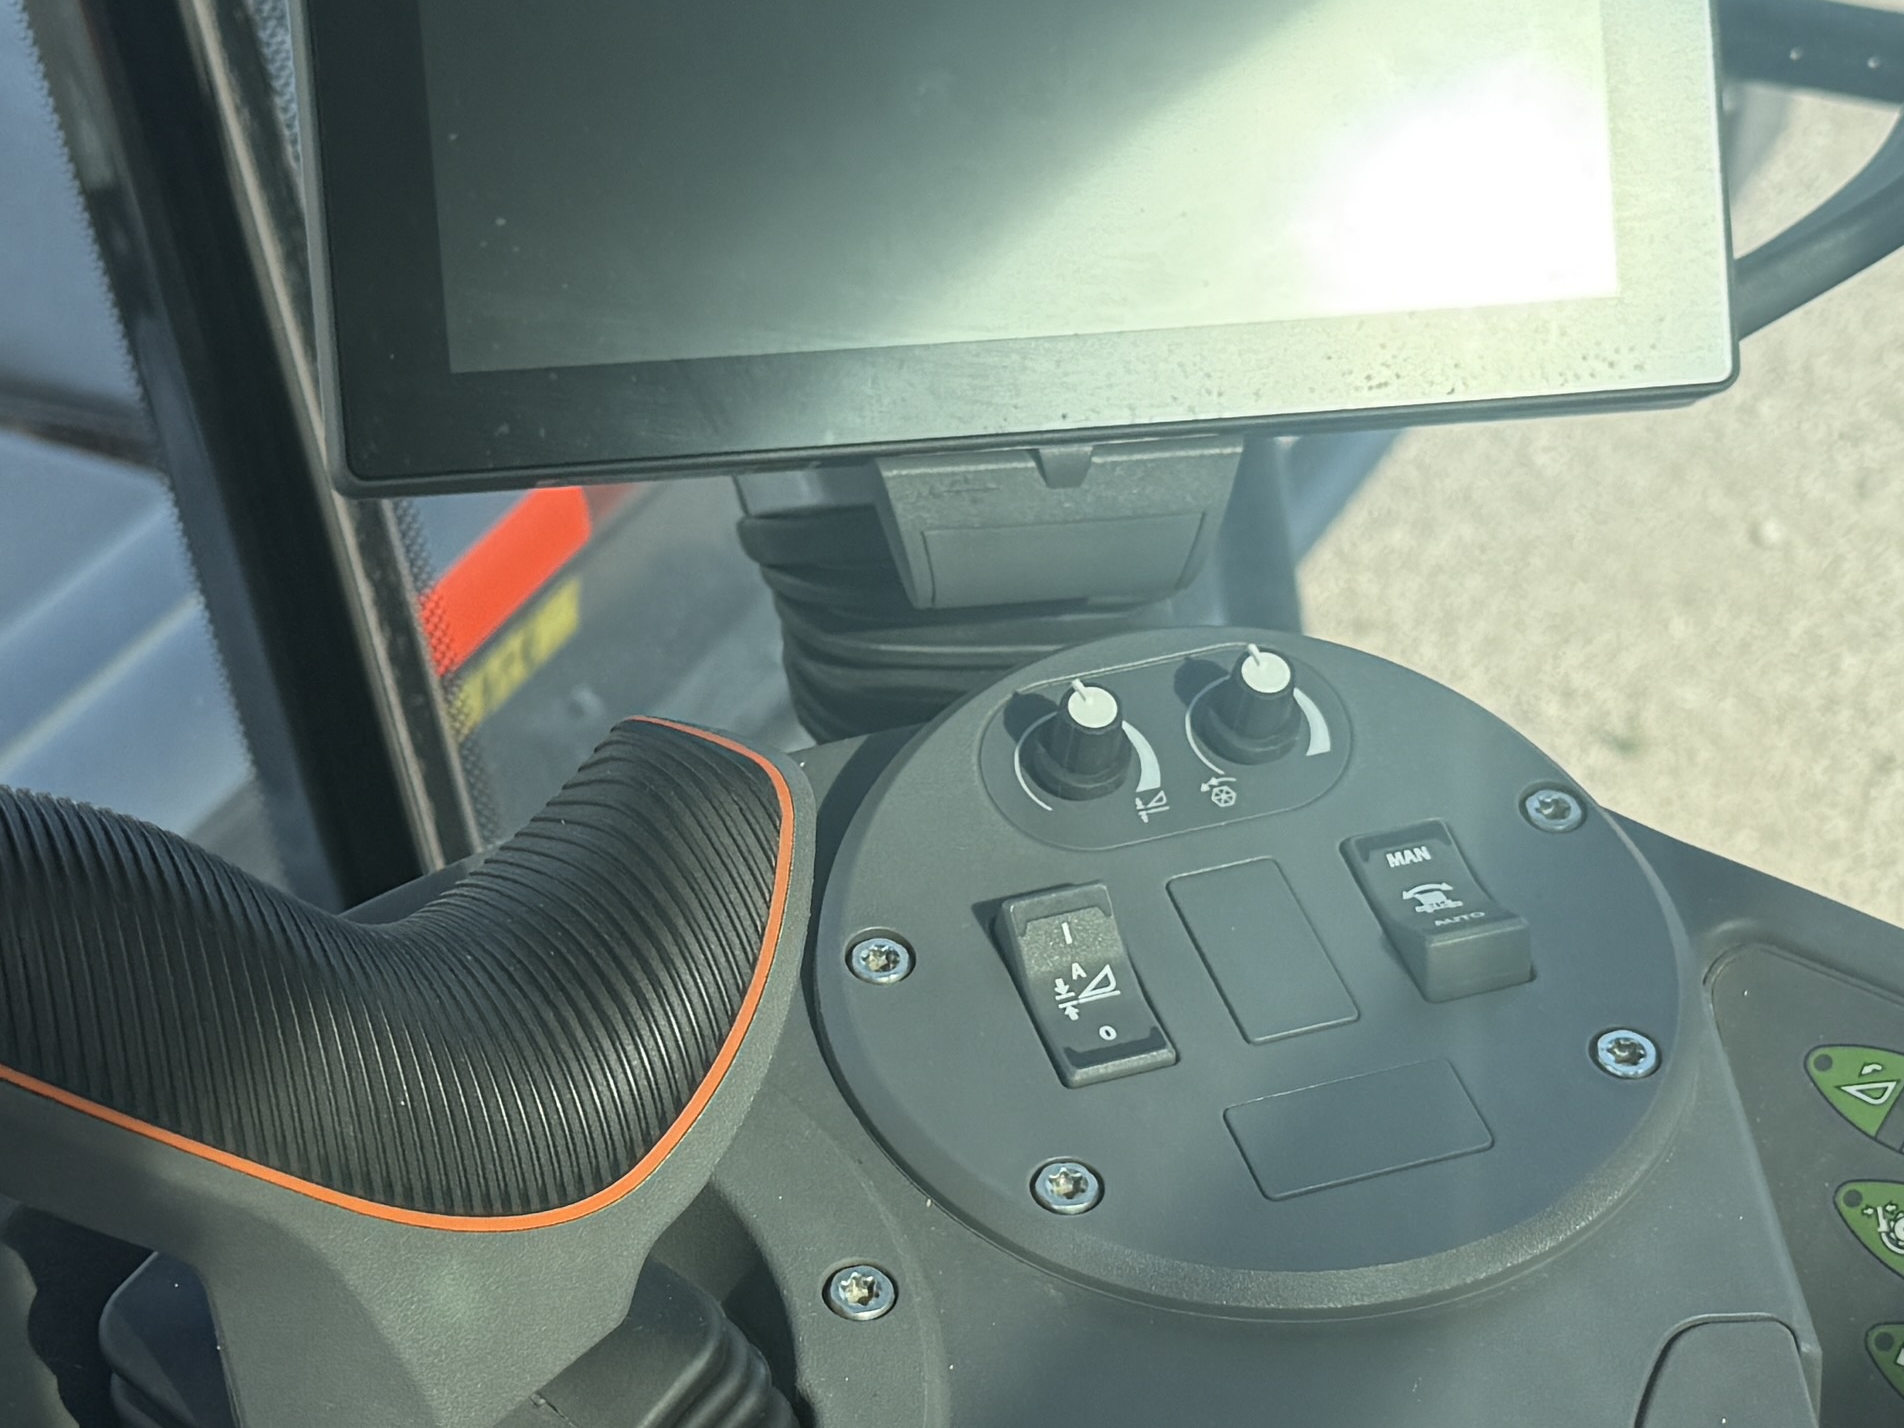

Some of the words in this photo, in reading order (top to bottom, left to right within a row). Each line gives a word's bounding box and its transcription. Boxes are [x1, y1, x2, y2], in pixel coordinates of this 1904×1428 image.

[1386, 845, 1432, 868] MAN
[1434, 912, 1485, 927] AUTO
[1071, 962, 1087, 980] A
